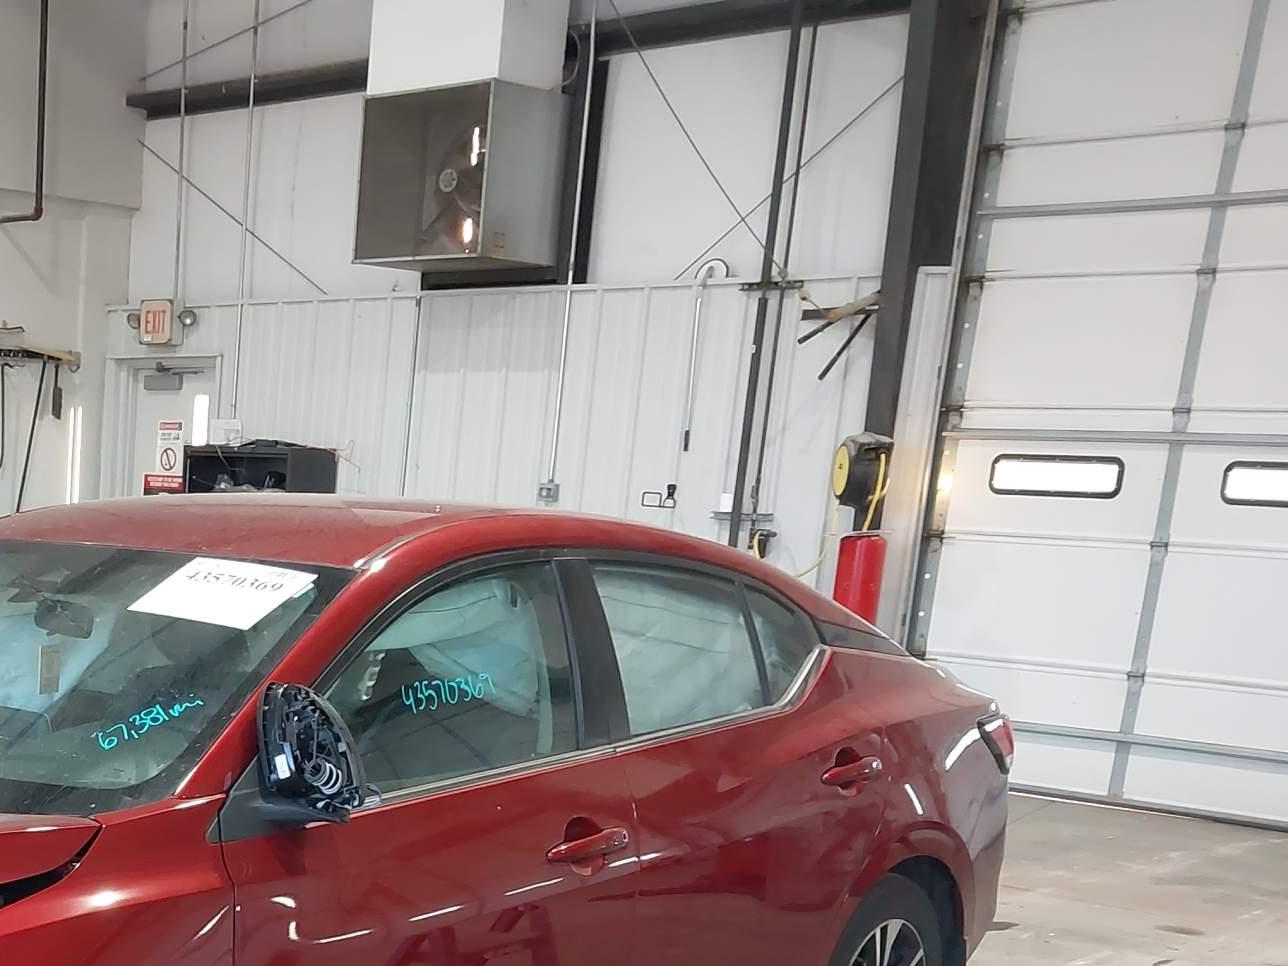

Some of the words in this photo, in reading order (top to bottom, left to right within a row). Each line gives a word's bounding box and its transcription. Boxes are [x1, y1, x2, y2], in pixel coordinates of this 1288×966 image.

[145, 310, 168, 335] EXIT
[185, 570, 285, 593] 43570369
[402, 672, 497, 715] 43570369
